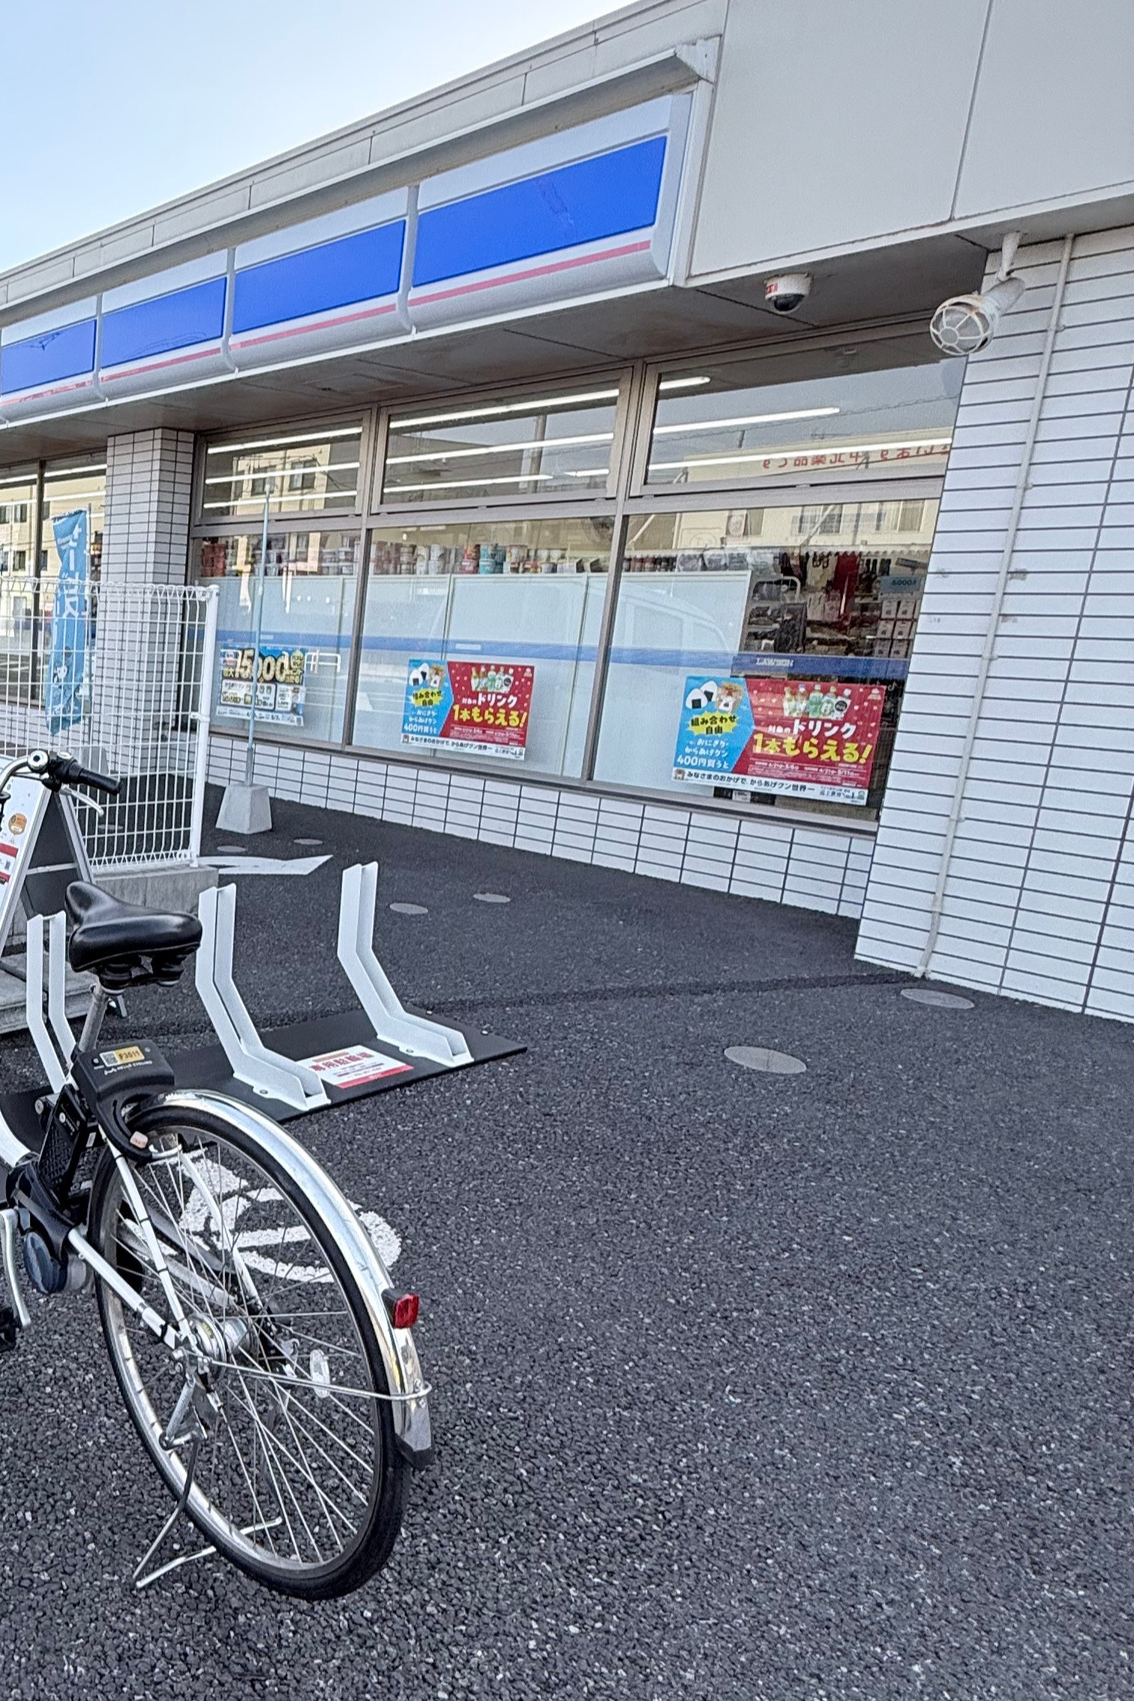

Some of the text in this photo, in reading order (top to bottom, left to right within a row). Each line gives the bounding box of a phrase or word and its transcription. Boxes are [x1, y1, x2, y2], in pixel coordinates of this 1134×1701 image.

[690, 715, 737, 726] 組み合わせ
[705, 726, 723, 735] 自由
[685, 746, 728, 758] からあげクン
[753, 732, 873, 764] 1本もらえる!
[677, 755, 729, 769] 400円買うと
